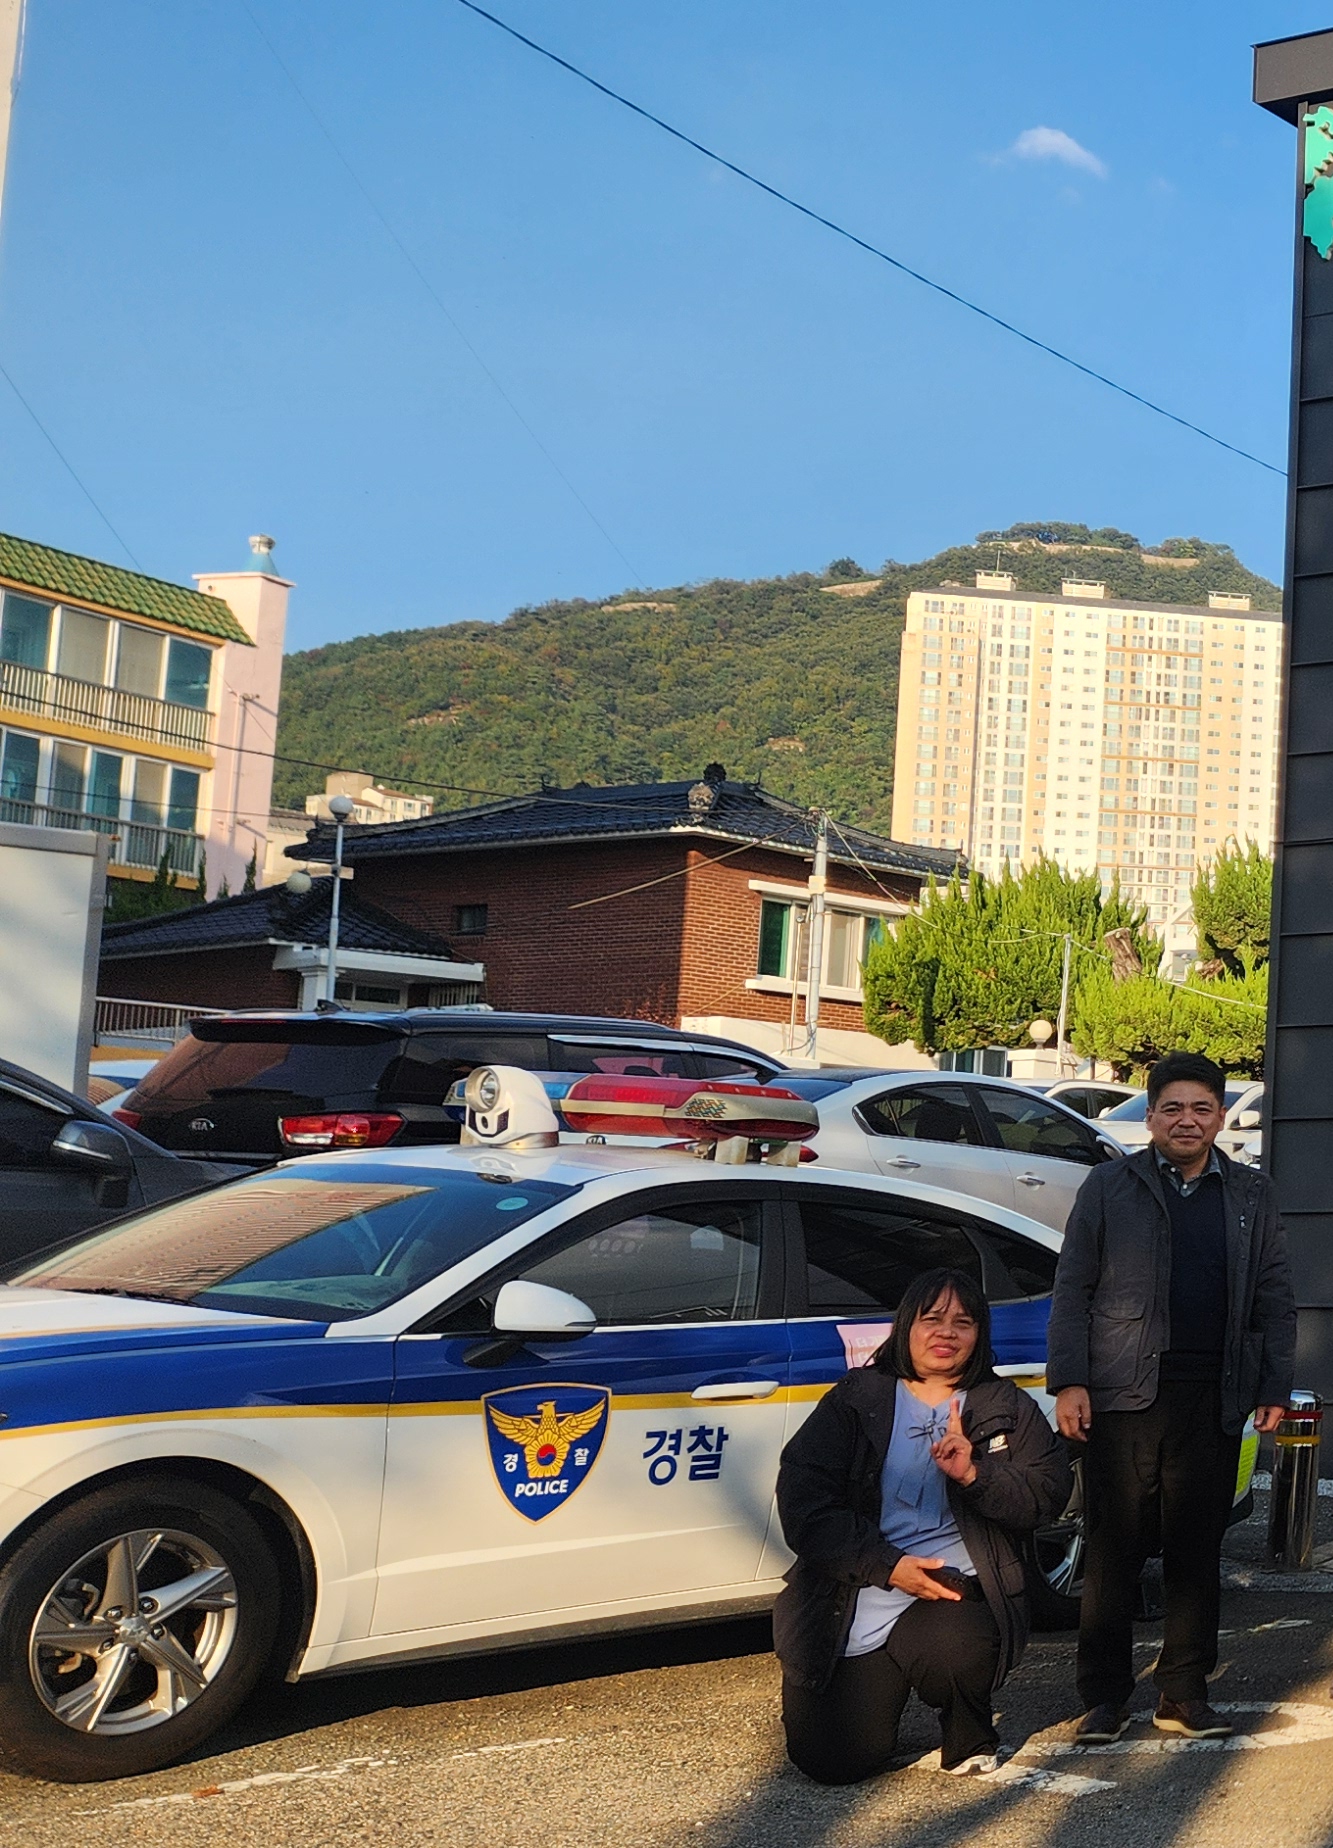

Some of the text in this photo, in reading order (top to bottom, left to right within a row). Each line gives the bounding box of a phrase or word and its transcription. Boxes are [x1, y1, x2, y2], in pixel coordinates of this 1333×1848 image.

[502, 1447, 590, 1473] 경 찰
[642, 1424, 729, 1486] 경찰
[514, 1479, 569, 1497] POLICE
